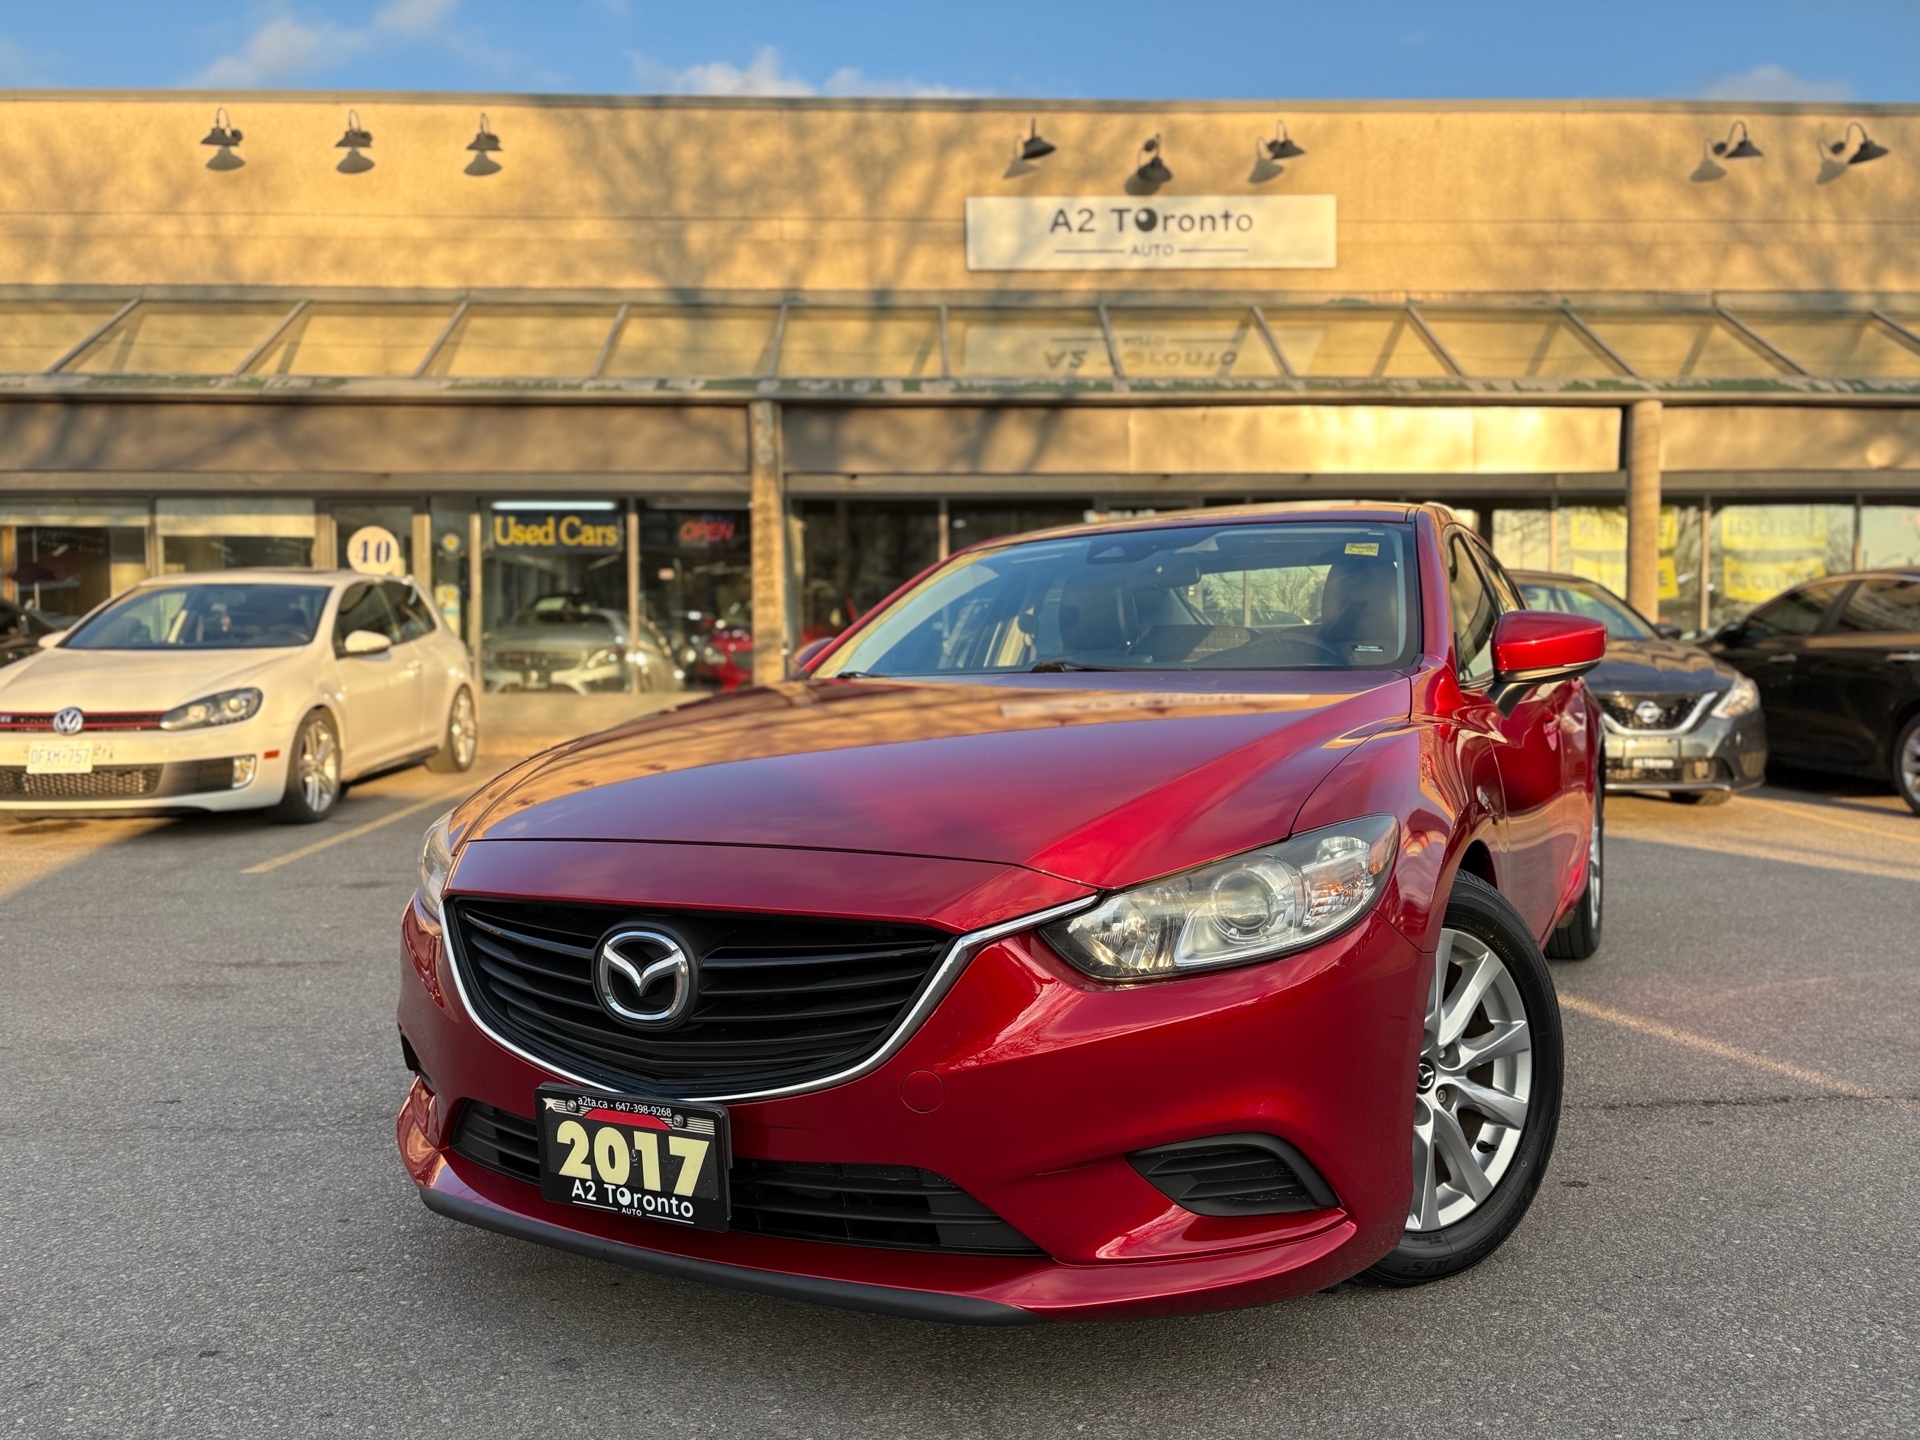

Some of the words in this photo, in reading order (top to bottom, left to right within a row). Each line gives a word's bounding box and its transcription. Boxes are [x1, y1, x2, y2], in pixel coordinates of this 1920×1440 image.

[1049, 207, 1096, 234] A2
[1130, 244, 1174, 258] AUTO
[494, 515, 555, 547] Used
[559, 515, 619, 547] Cars
[577, 1095, 608, 1110] a2ta.ca
[615, 1101, 672, 1117] 647-398-9268
[556, 1119, 710, 1198] 2017
[571, 1178, 597, 1201] A2
[621, 1206, 643, 1217] AUTO
